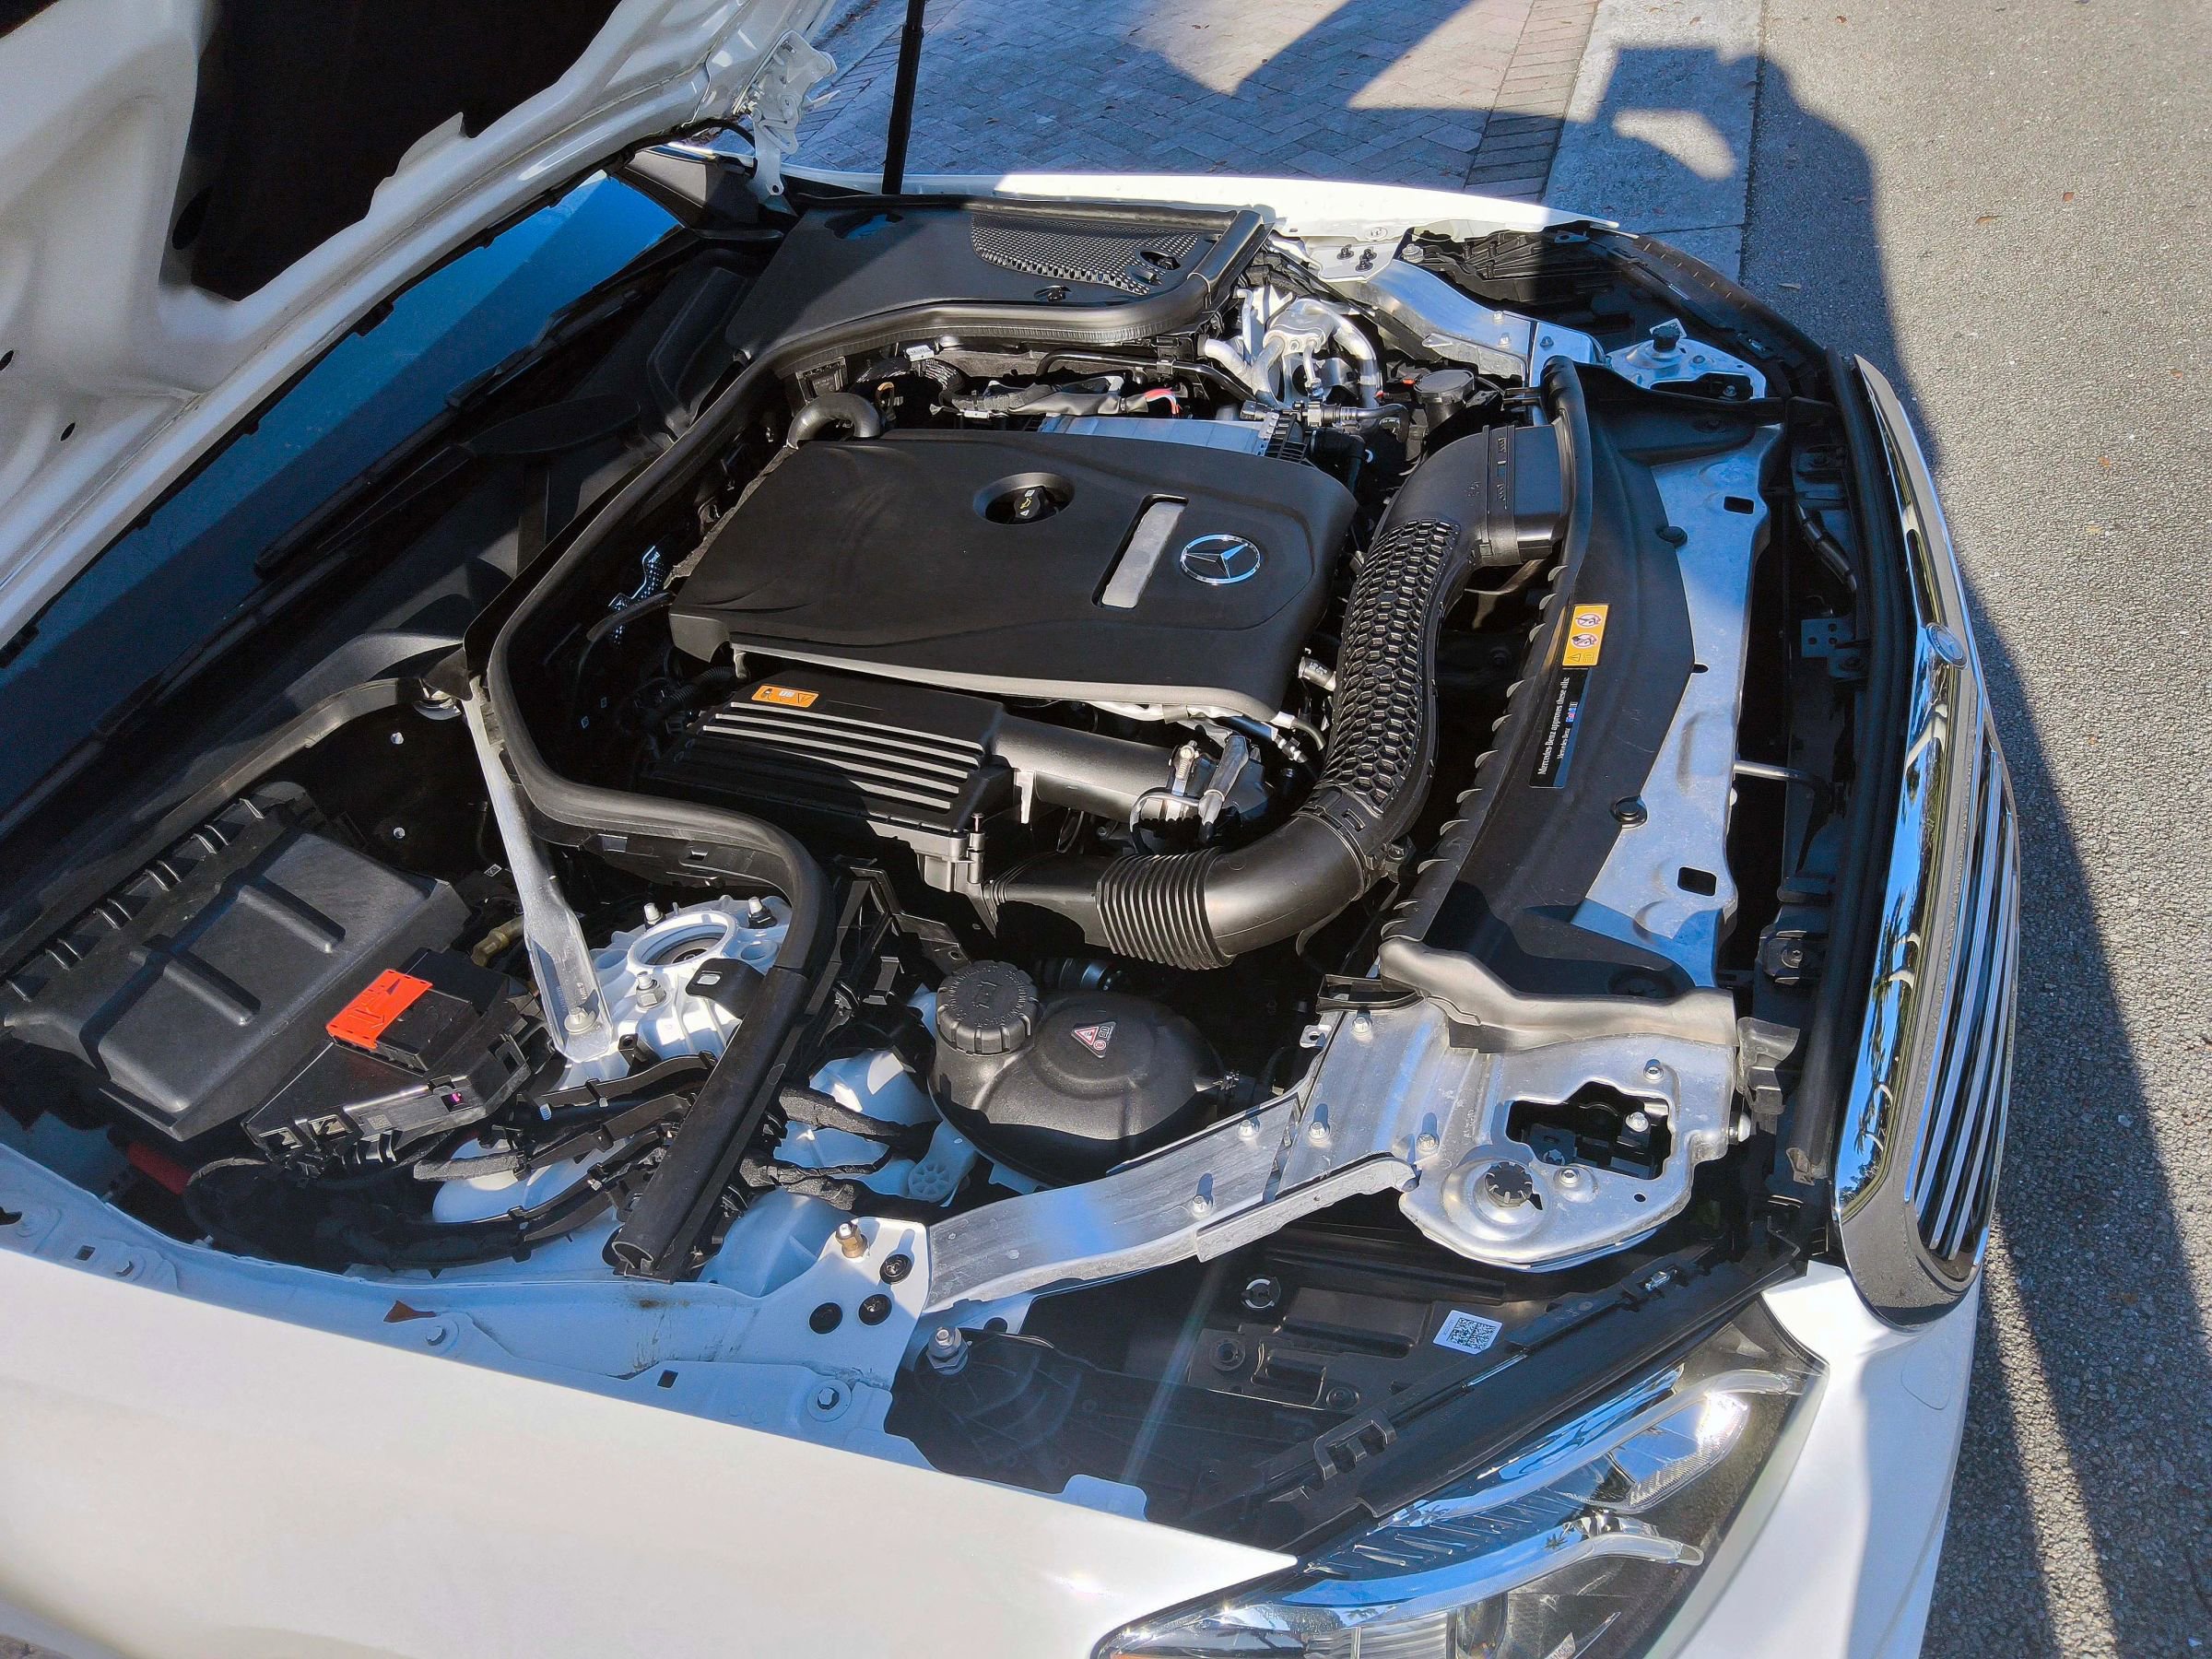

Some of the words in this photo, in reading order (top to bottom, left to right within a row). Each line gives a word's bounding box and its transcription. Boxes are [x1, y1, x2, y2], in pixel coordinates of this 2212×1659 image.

[1556, 689, 1567, 705] these
[1551, 705, 1563, 731] approves
[1537, 731, 1557, 775] Mercedes-Benz
